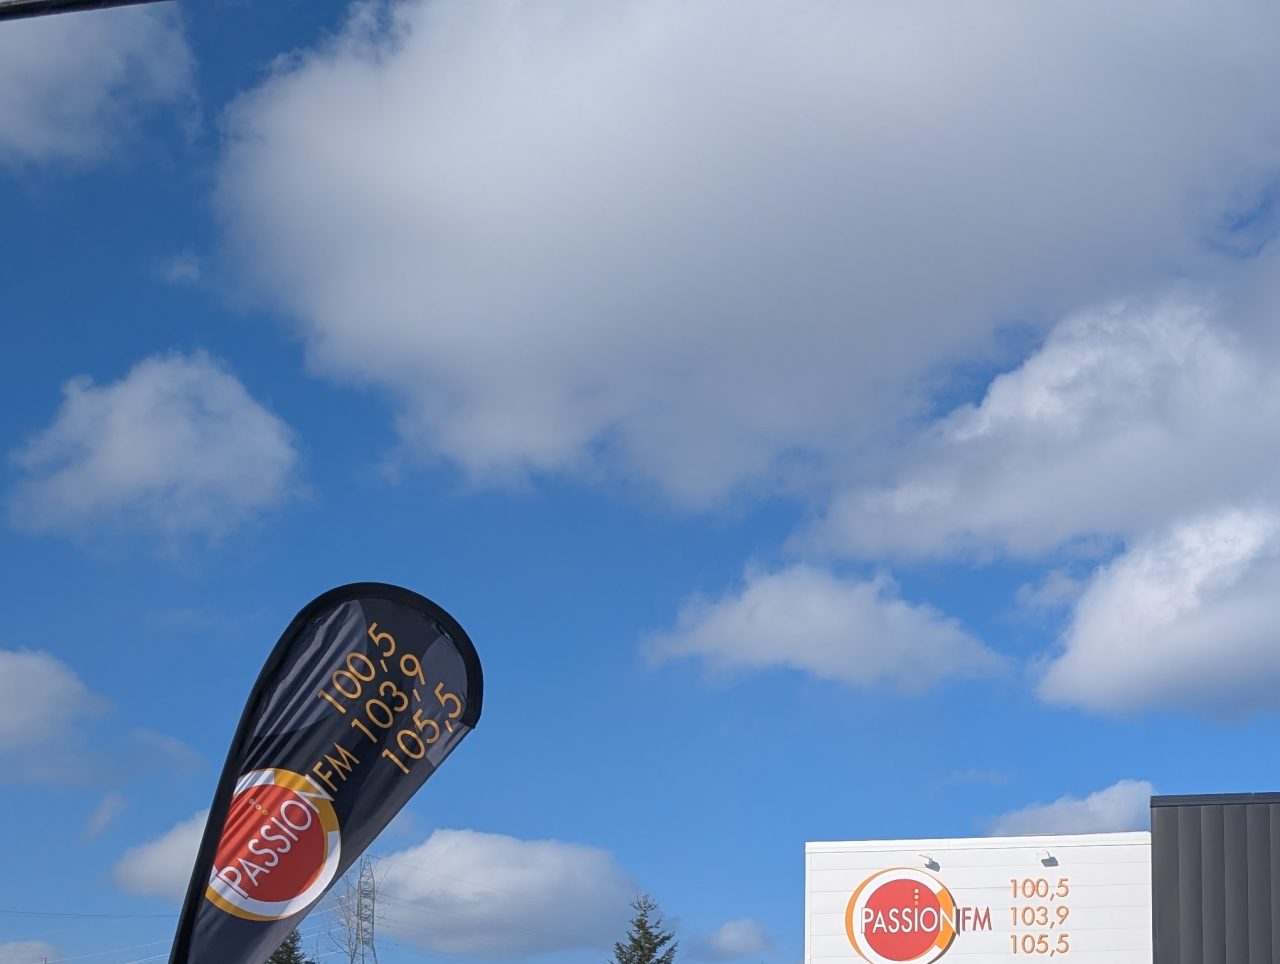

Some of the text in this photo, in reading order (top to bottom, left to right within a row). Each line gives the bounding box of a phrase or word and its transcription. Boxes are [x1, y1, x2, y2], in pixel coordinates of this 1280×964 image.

[318, 622, 396, 714] 100,5
[351, 653, 426, 743] 103,9
[381, 682, 462, 774] 105,5
[1010, 878, 1070, 901] 100,5
[1010, 905, 1070, 929] 103,9
[1010, 933, 1070, 957] 105,5
